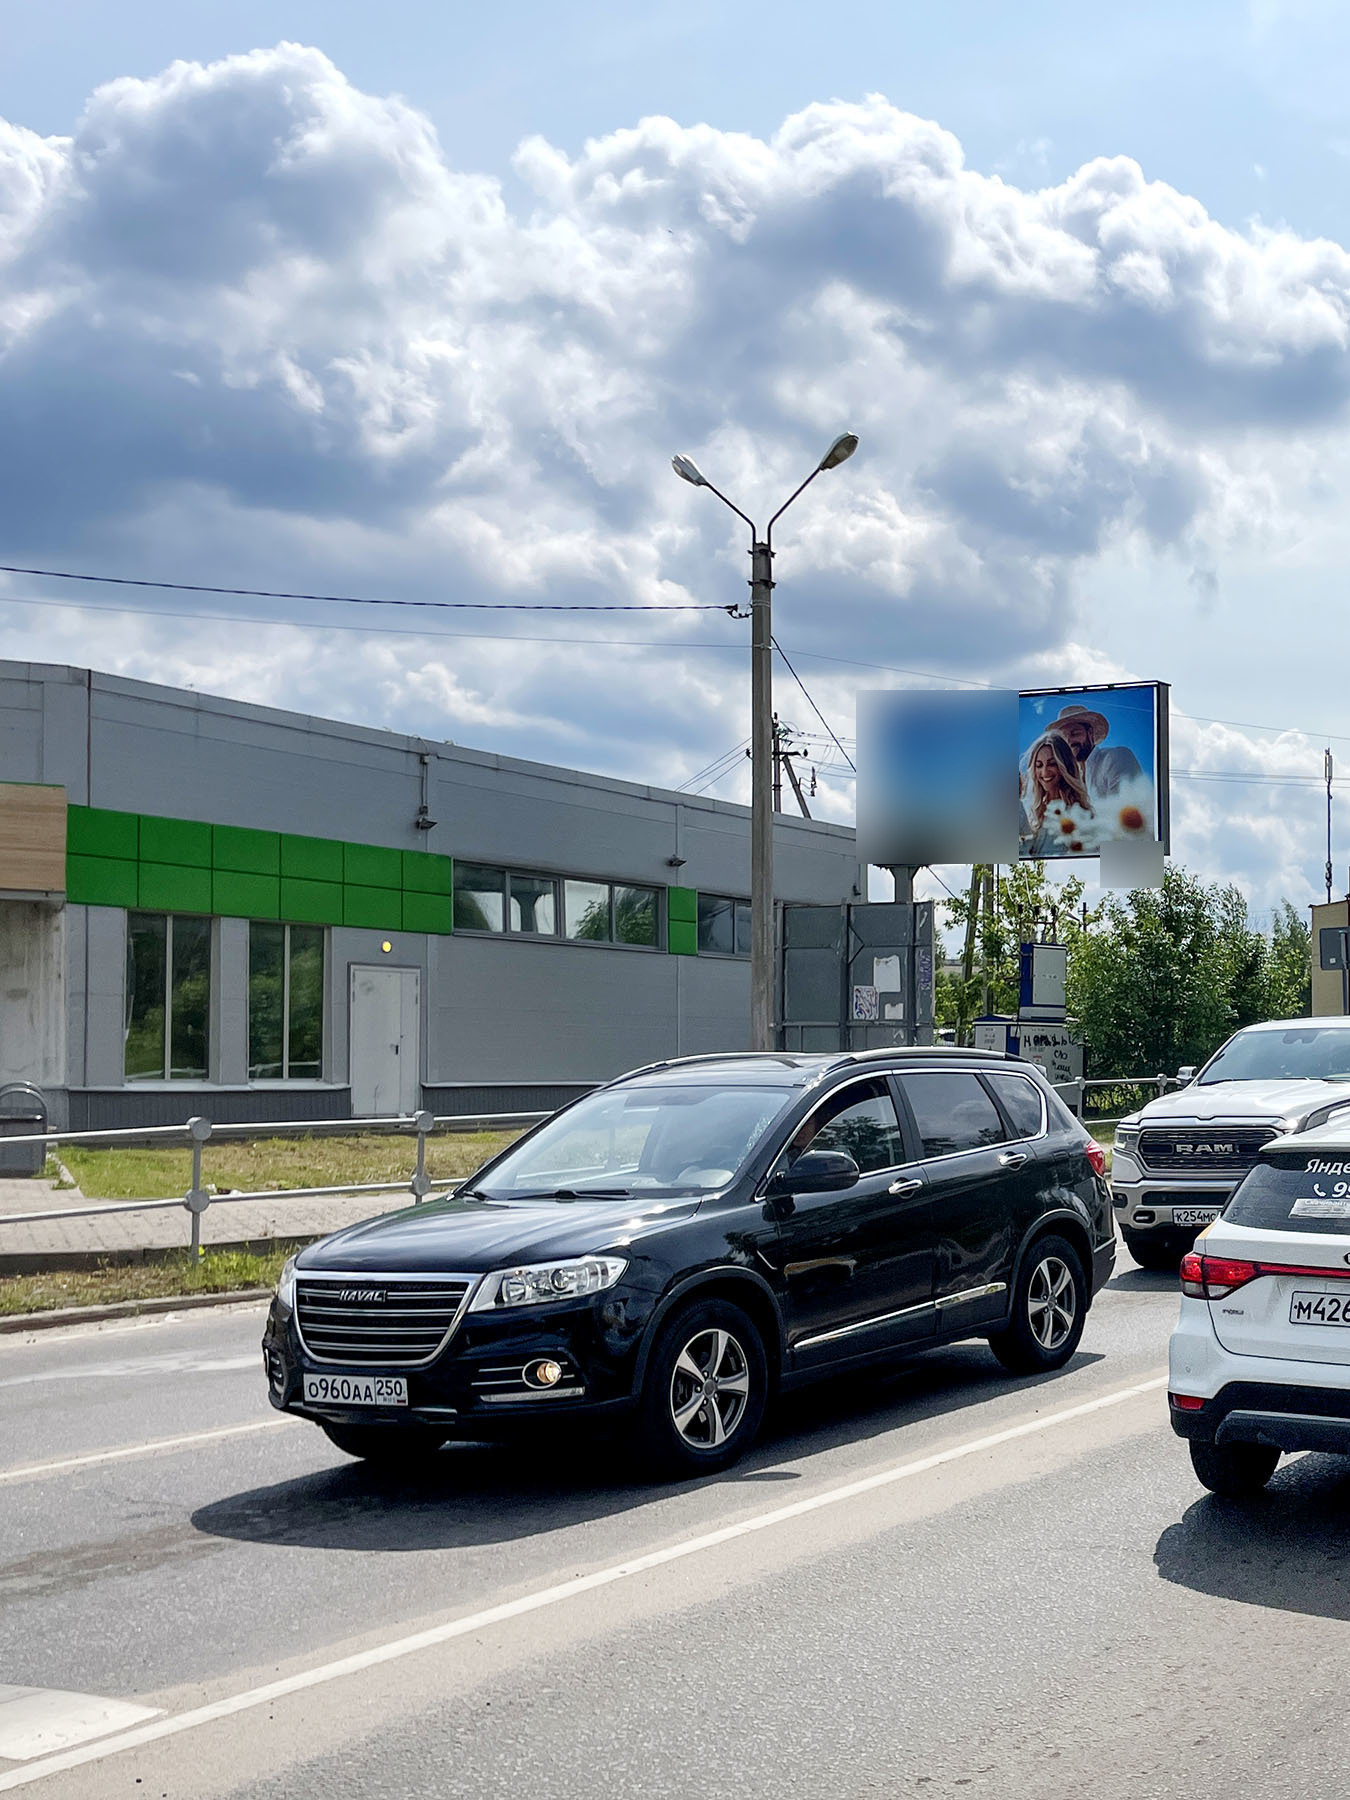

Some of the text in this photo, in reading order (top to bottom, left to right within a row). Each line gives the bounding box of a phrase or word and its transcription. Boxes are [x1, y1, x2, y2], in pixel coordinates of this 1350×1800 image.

[1176, 1144, 1233, 1153] RAM
[308, 1378, 403, 1402] О960АА 250
